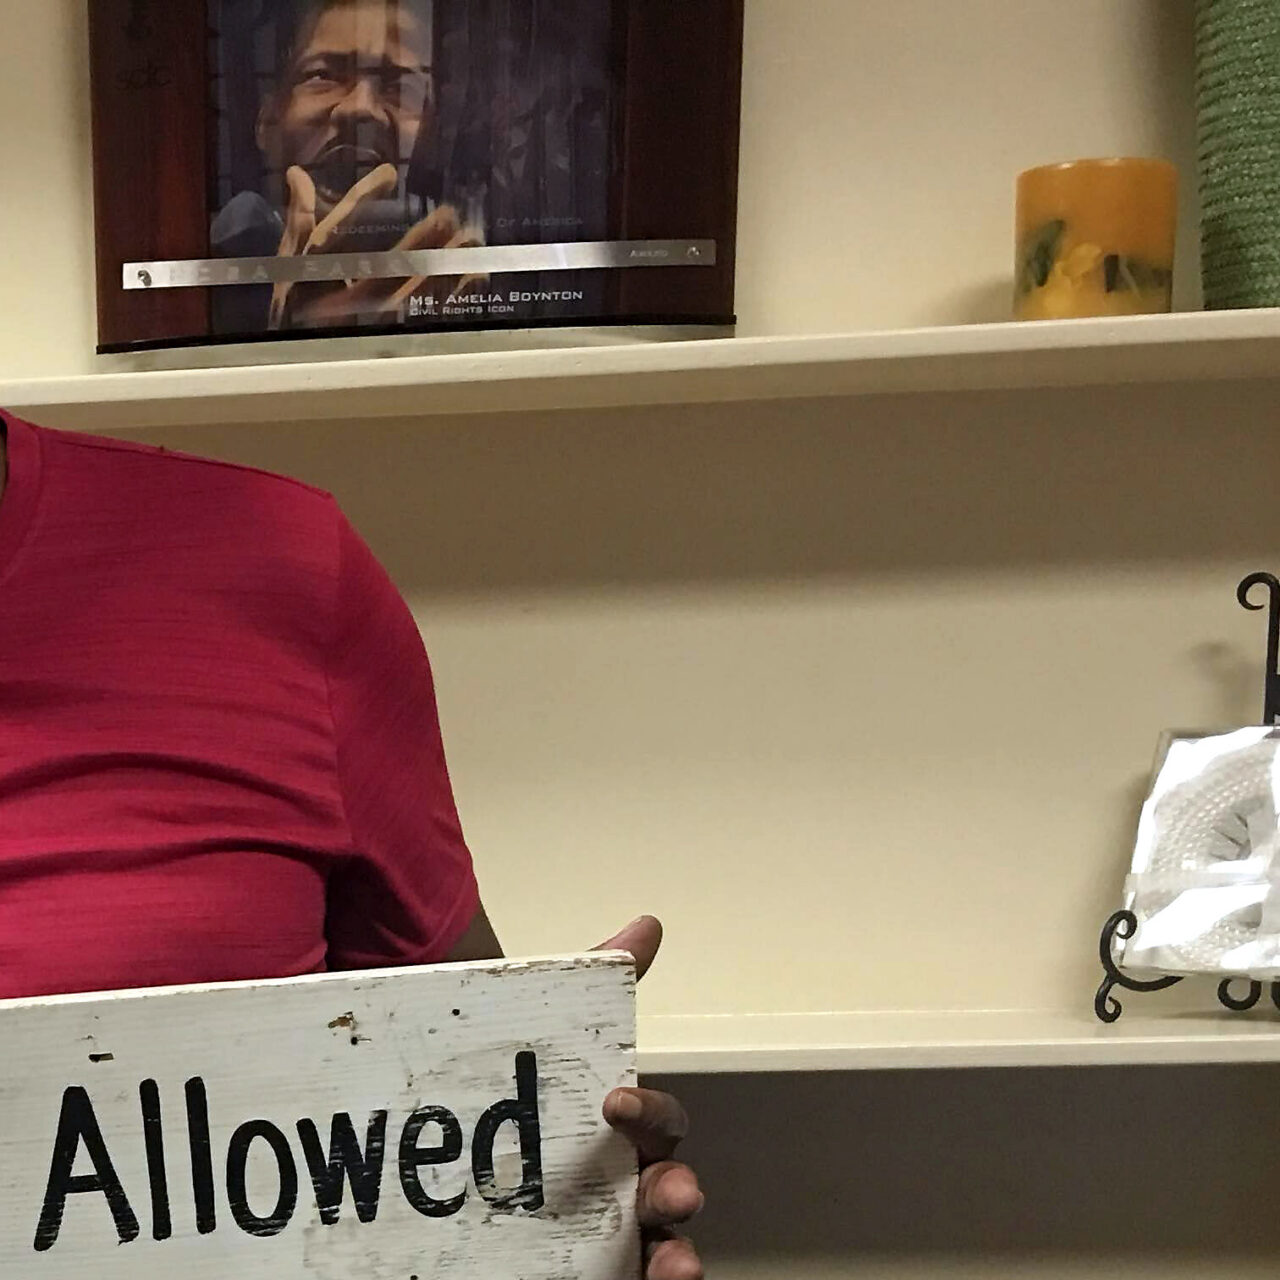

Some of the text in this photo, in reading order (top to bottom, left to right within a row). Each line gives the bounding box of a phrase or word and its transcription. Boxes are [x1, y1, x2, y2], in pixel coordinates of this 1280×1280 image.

[445, 293, 503, 305] AMELIA
[509, 290, 583, 302] BOYNTON
[34, 1052, 542, 1251] Allowed
